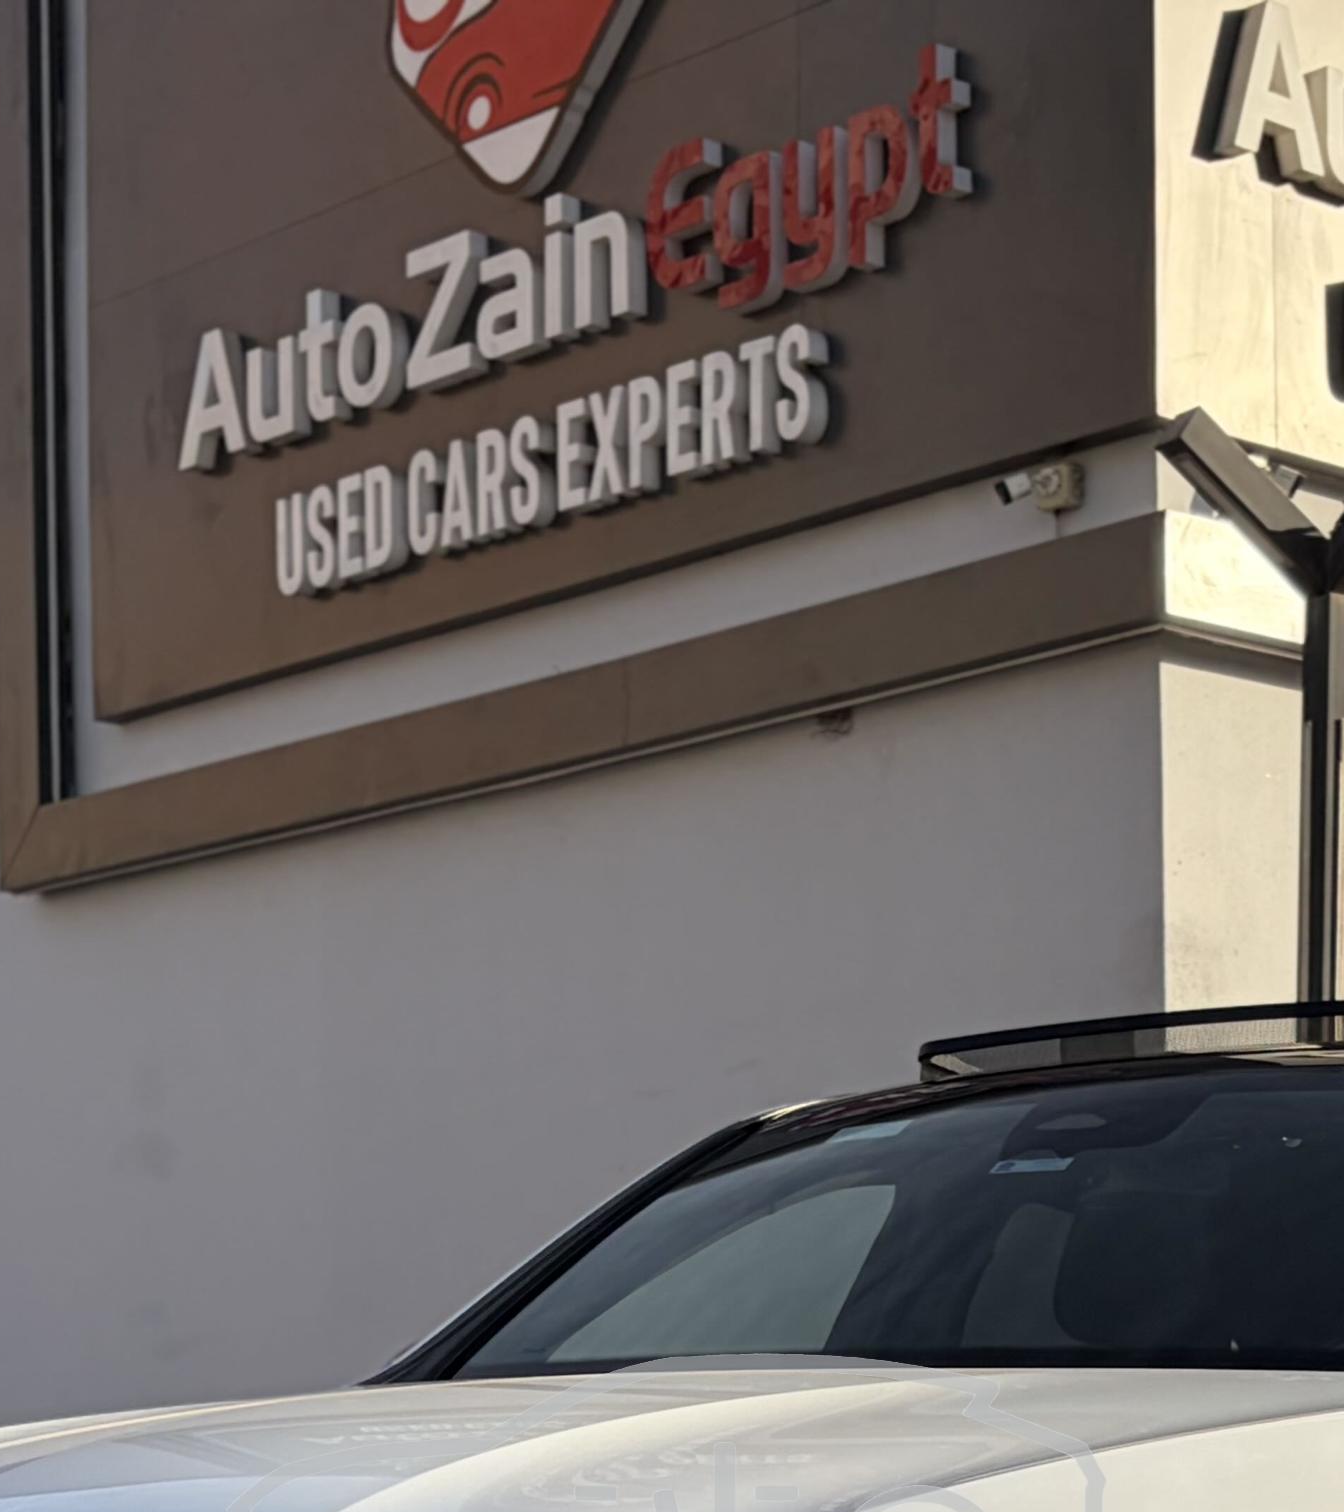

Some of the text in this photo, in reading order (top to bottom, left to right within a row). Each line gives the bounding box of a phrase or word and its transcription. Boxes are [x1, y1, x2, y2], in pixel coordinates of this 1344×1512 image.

[178, 42, 972, 471] Auto Zain Egypt
[274, 323, 824, 596] USED CARS EXPERTS
